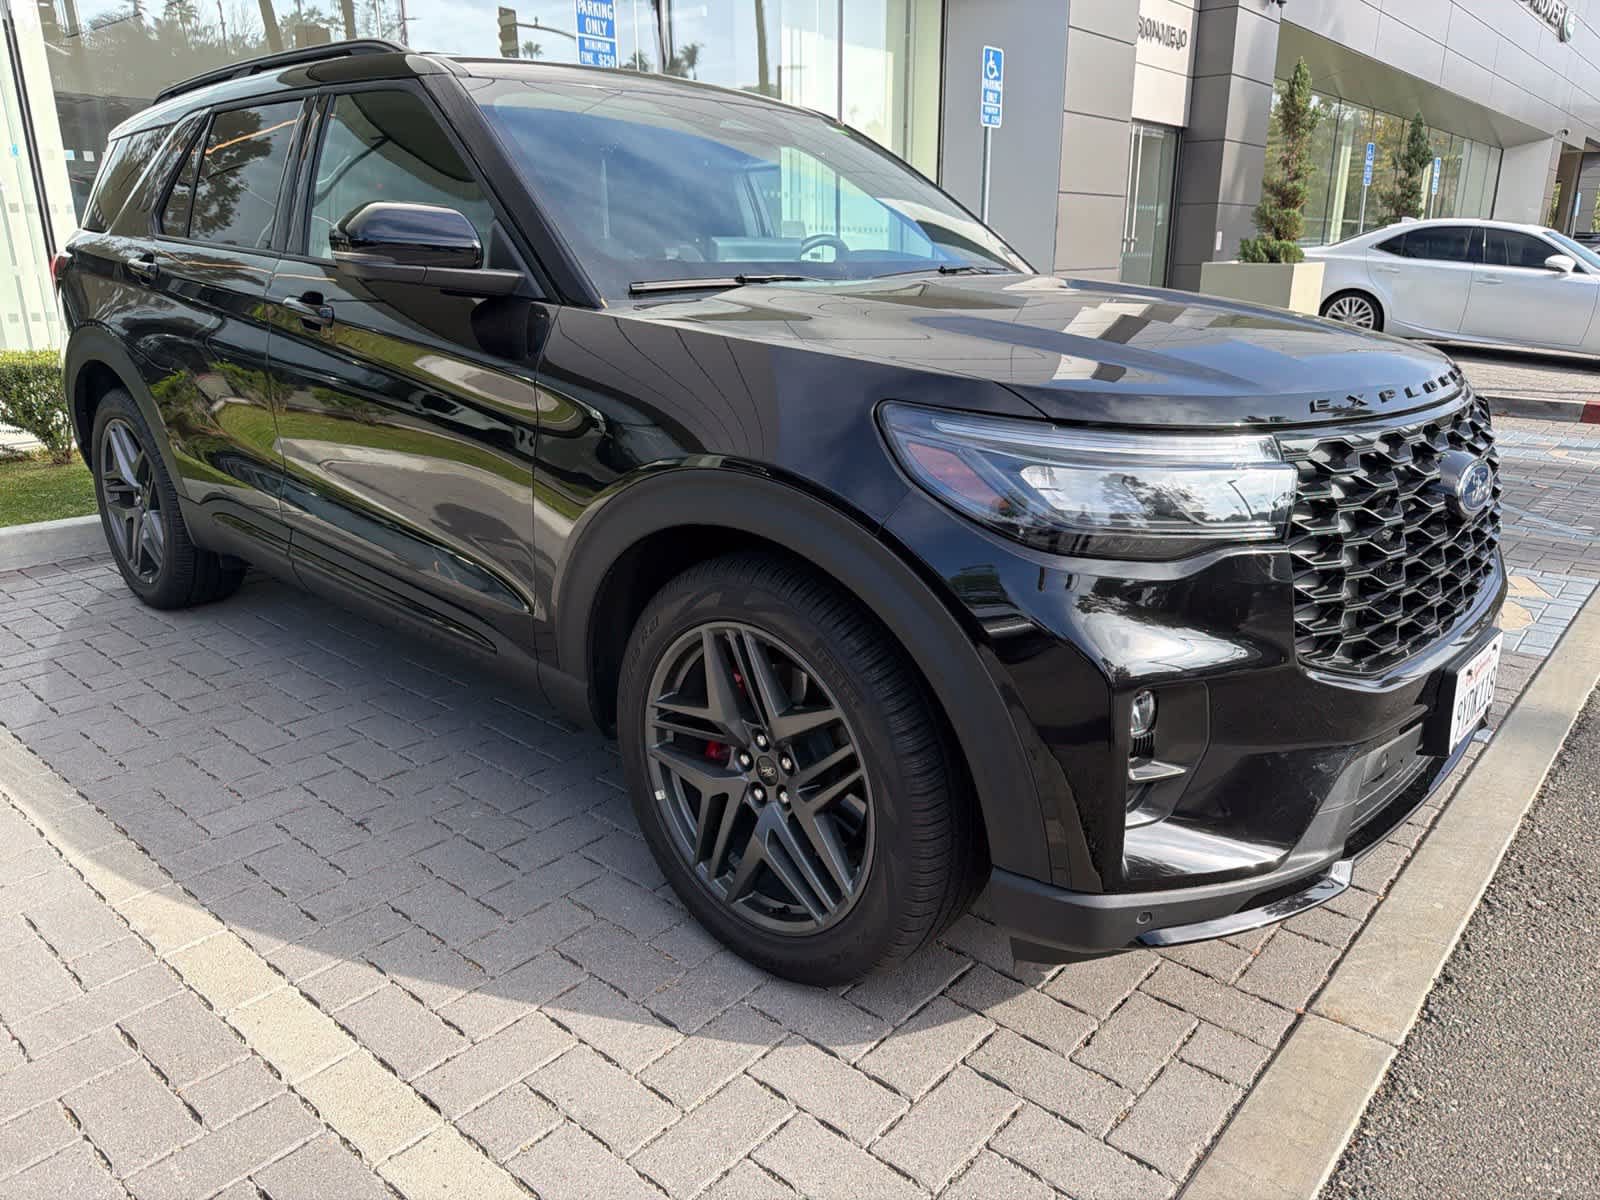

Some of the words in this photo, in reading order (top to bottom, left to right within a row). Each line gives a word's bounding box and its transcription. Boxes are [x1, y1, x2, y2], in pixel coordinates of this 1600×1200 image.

[578, 0, 613, 20] PARKING
[585, 17, 608, 36] ONLY
[1309, 364, 1462, 413] EXPLOR
